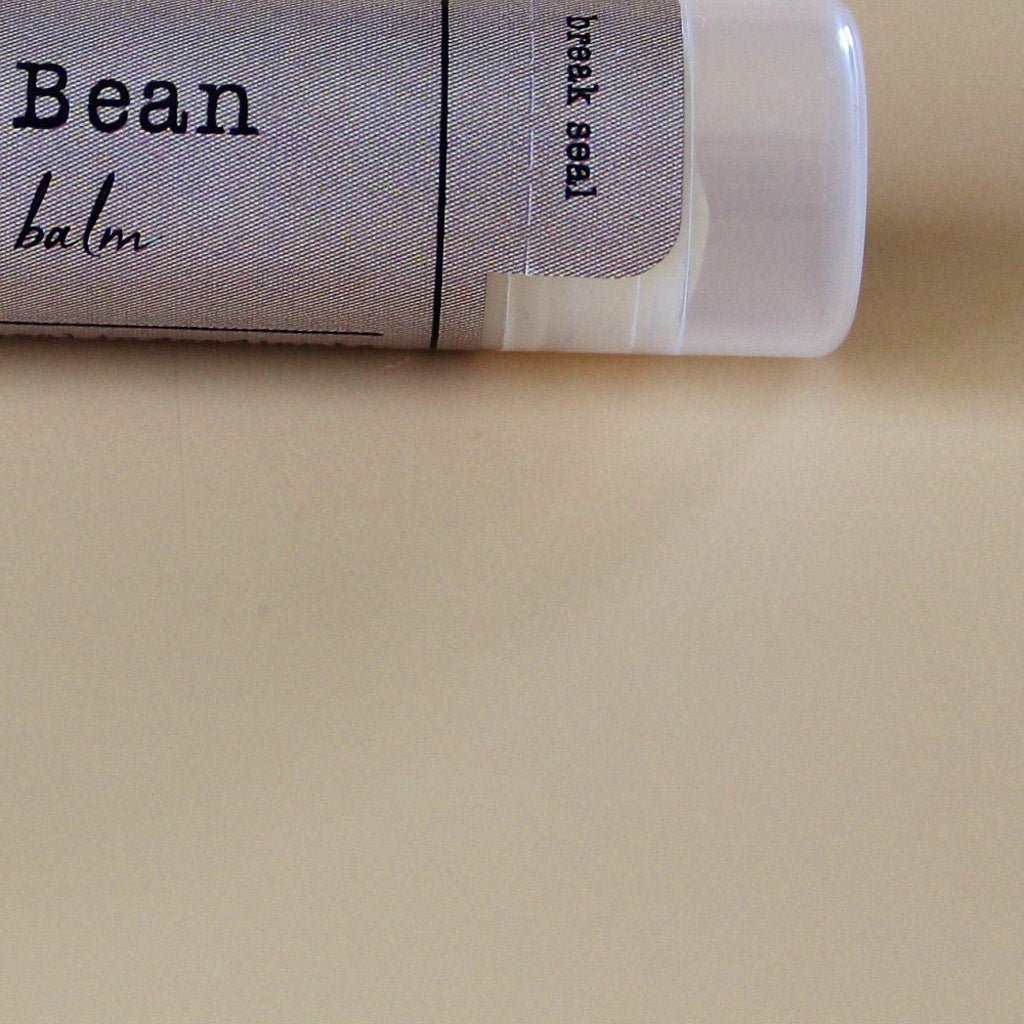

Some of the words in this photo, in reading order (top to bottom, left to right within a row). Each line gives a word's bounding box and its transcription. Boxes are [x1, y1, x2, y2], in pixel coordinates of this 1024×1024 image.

[11, 60, 260, 137] Bean
[564, 14, 600, 106] break
[564, 121, 598, 201] seal
[13, 170, 163, 258] balm
